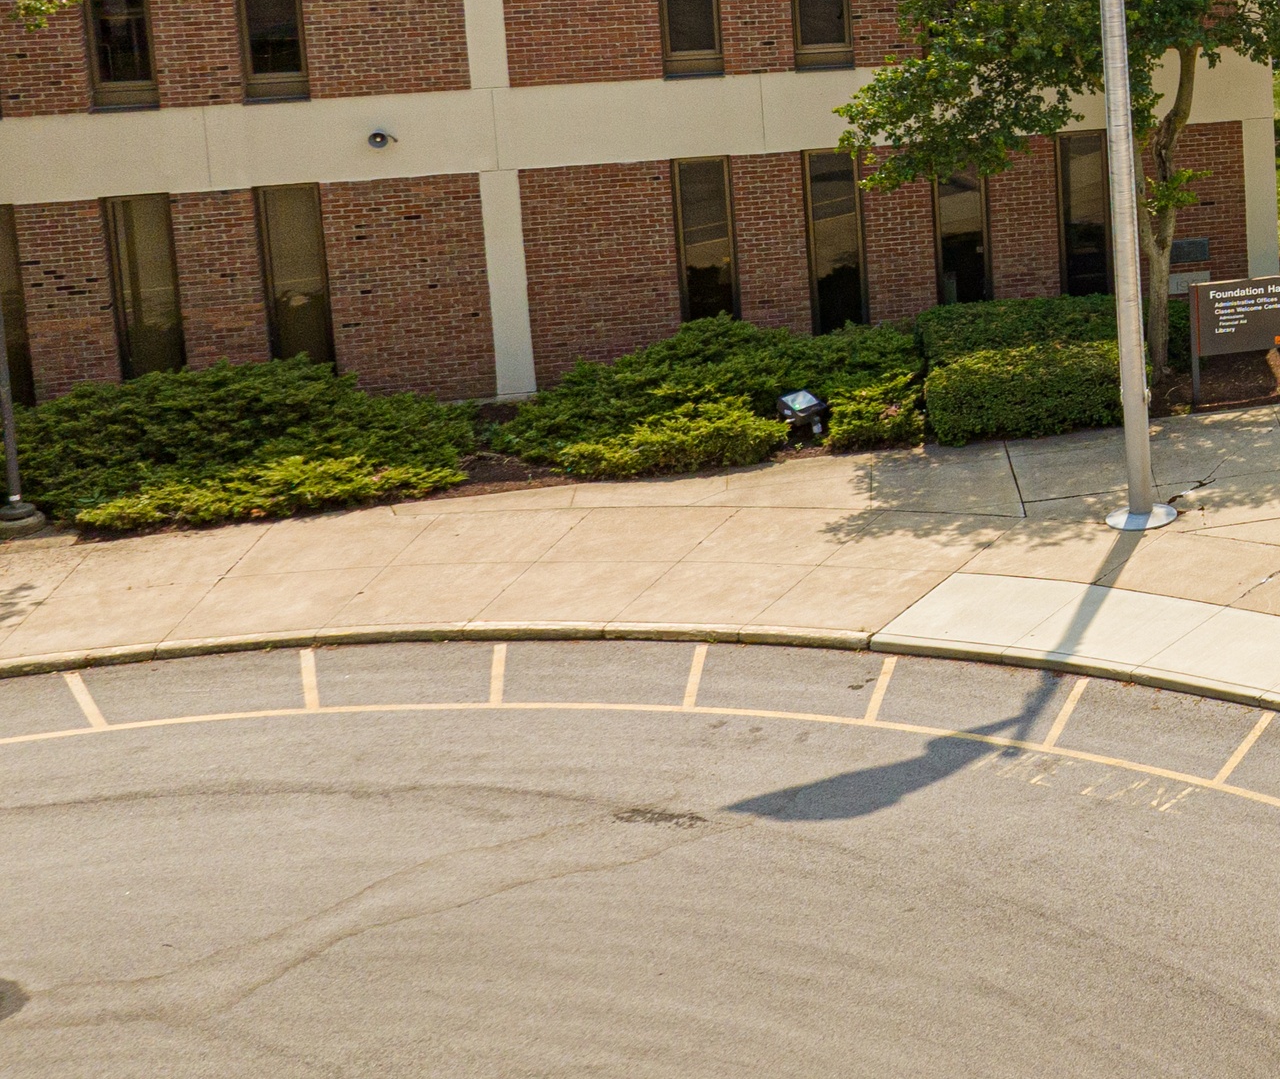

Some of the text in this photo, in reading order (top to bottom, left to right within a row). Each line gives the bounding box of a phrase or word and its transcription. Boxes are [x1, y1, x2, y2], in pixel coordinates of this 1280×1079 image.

[1210, 287, 1264, 299] Foundation
[1215, 299, 1255, 308] Administrative
[1236, 305, 1263, 313] Welcome
